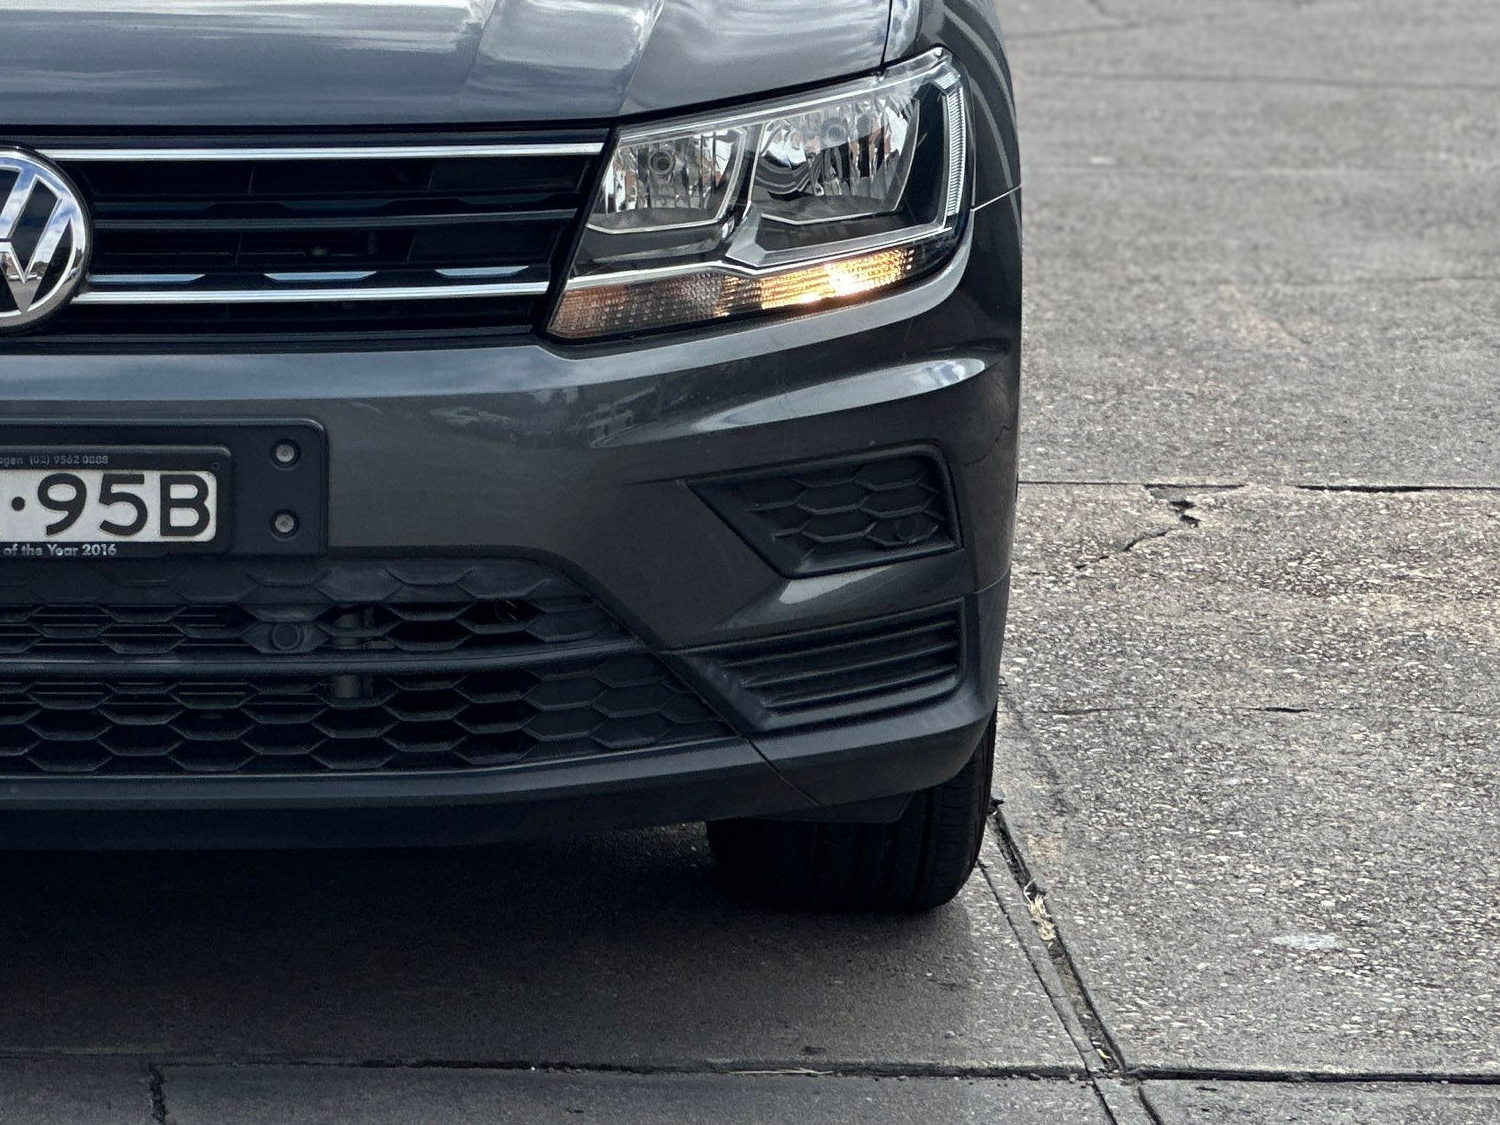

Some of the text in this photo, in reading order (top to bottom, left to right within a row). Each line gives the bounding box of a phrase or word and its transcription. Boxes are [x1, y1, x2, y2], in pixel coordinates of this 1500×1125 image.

[3, 543, 19, 556] of
[21, 543, 43, 556] the
[47, 543, 79, 556] Year
[81, 543, 118, 556] 2016
